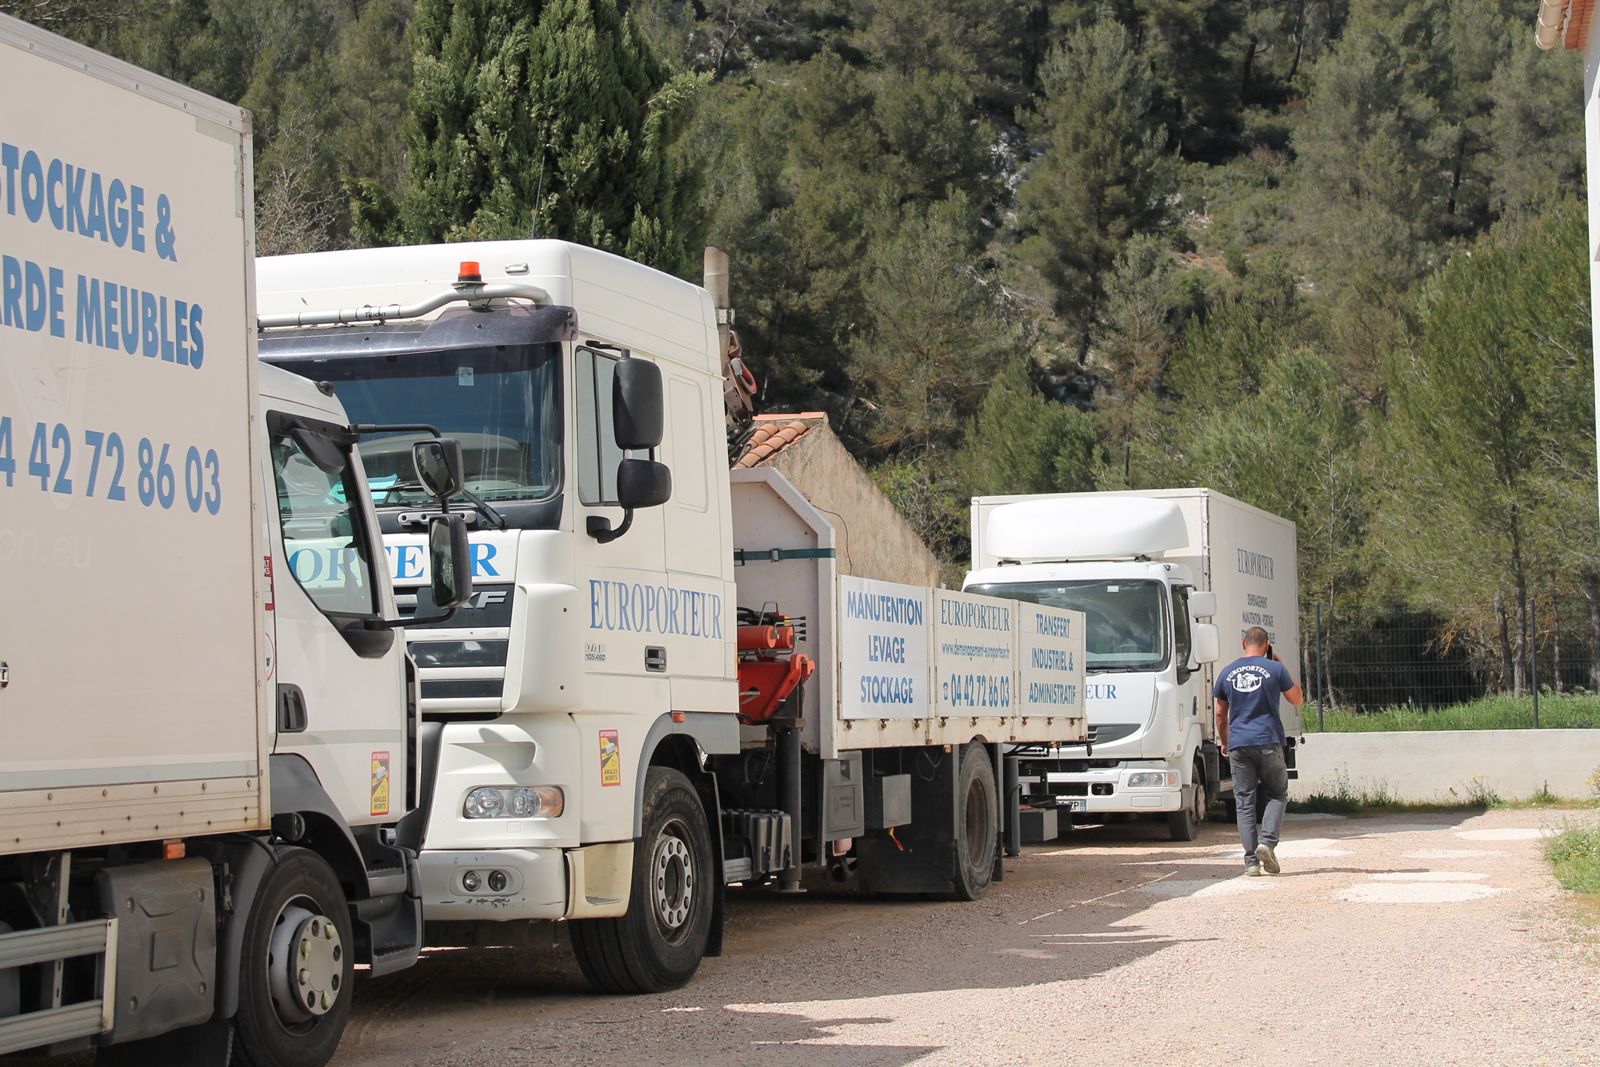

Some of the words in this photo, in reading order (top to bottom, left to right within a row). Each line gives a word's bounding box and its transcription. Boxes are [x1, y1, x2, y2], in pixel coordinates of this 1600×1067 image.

[0, 142, 145, 253] TOCKAGE
[155, 193, 178, 262] &
[76, 274, 205, 370] MEUBLES
[29, 422, 73, 495] 42
[85, 430, 126, 501] 72
[138, 437, 175, 509] 86
[185, 446, 222, 515] 03
[589, 579, 722, 639] EUROPORTEUR
[847, 591, 922, 626] MANUTENTION
[941, 598, 1010, 632] EUROPORTEUR
[1036, 613, 1070, 638] TRANSFERT
[868, 634, 905, 664] LEVAGE
[1032, 647, 1067, 671] INDUSTRIEL
[860, 675, 913, 704] STOCKAGE
[951, 673, 962, 707] 04
[964, 674, 974, 707] 42
[976, 675, 987, 707] 72
[989, 675, 998, 707] 86
[1000, 675, 1009, 708] 03
[1226, 665, 1271, 682] EUROPORTEUR
[1028, 682, 1076, 705] ADMINISTRATIF
